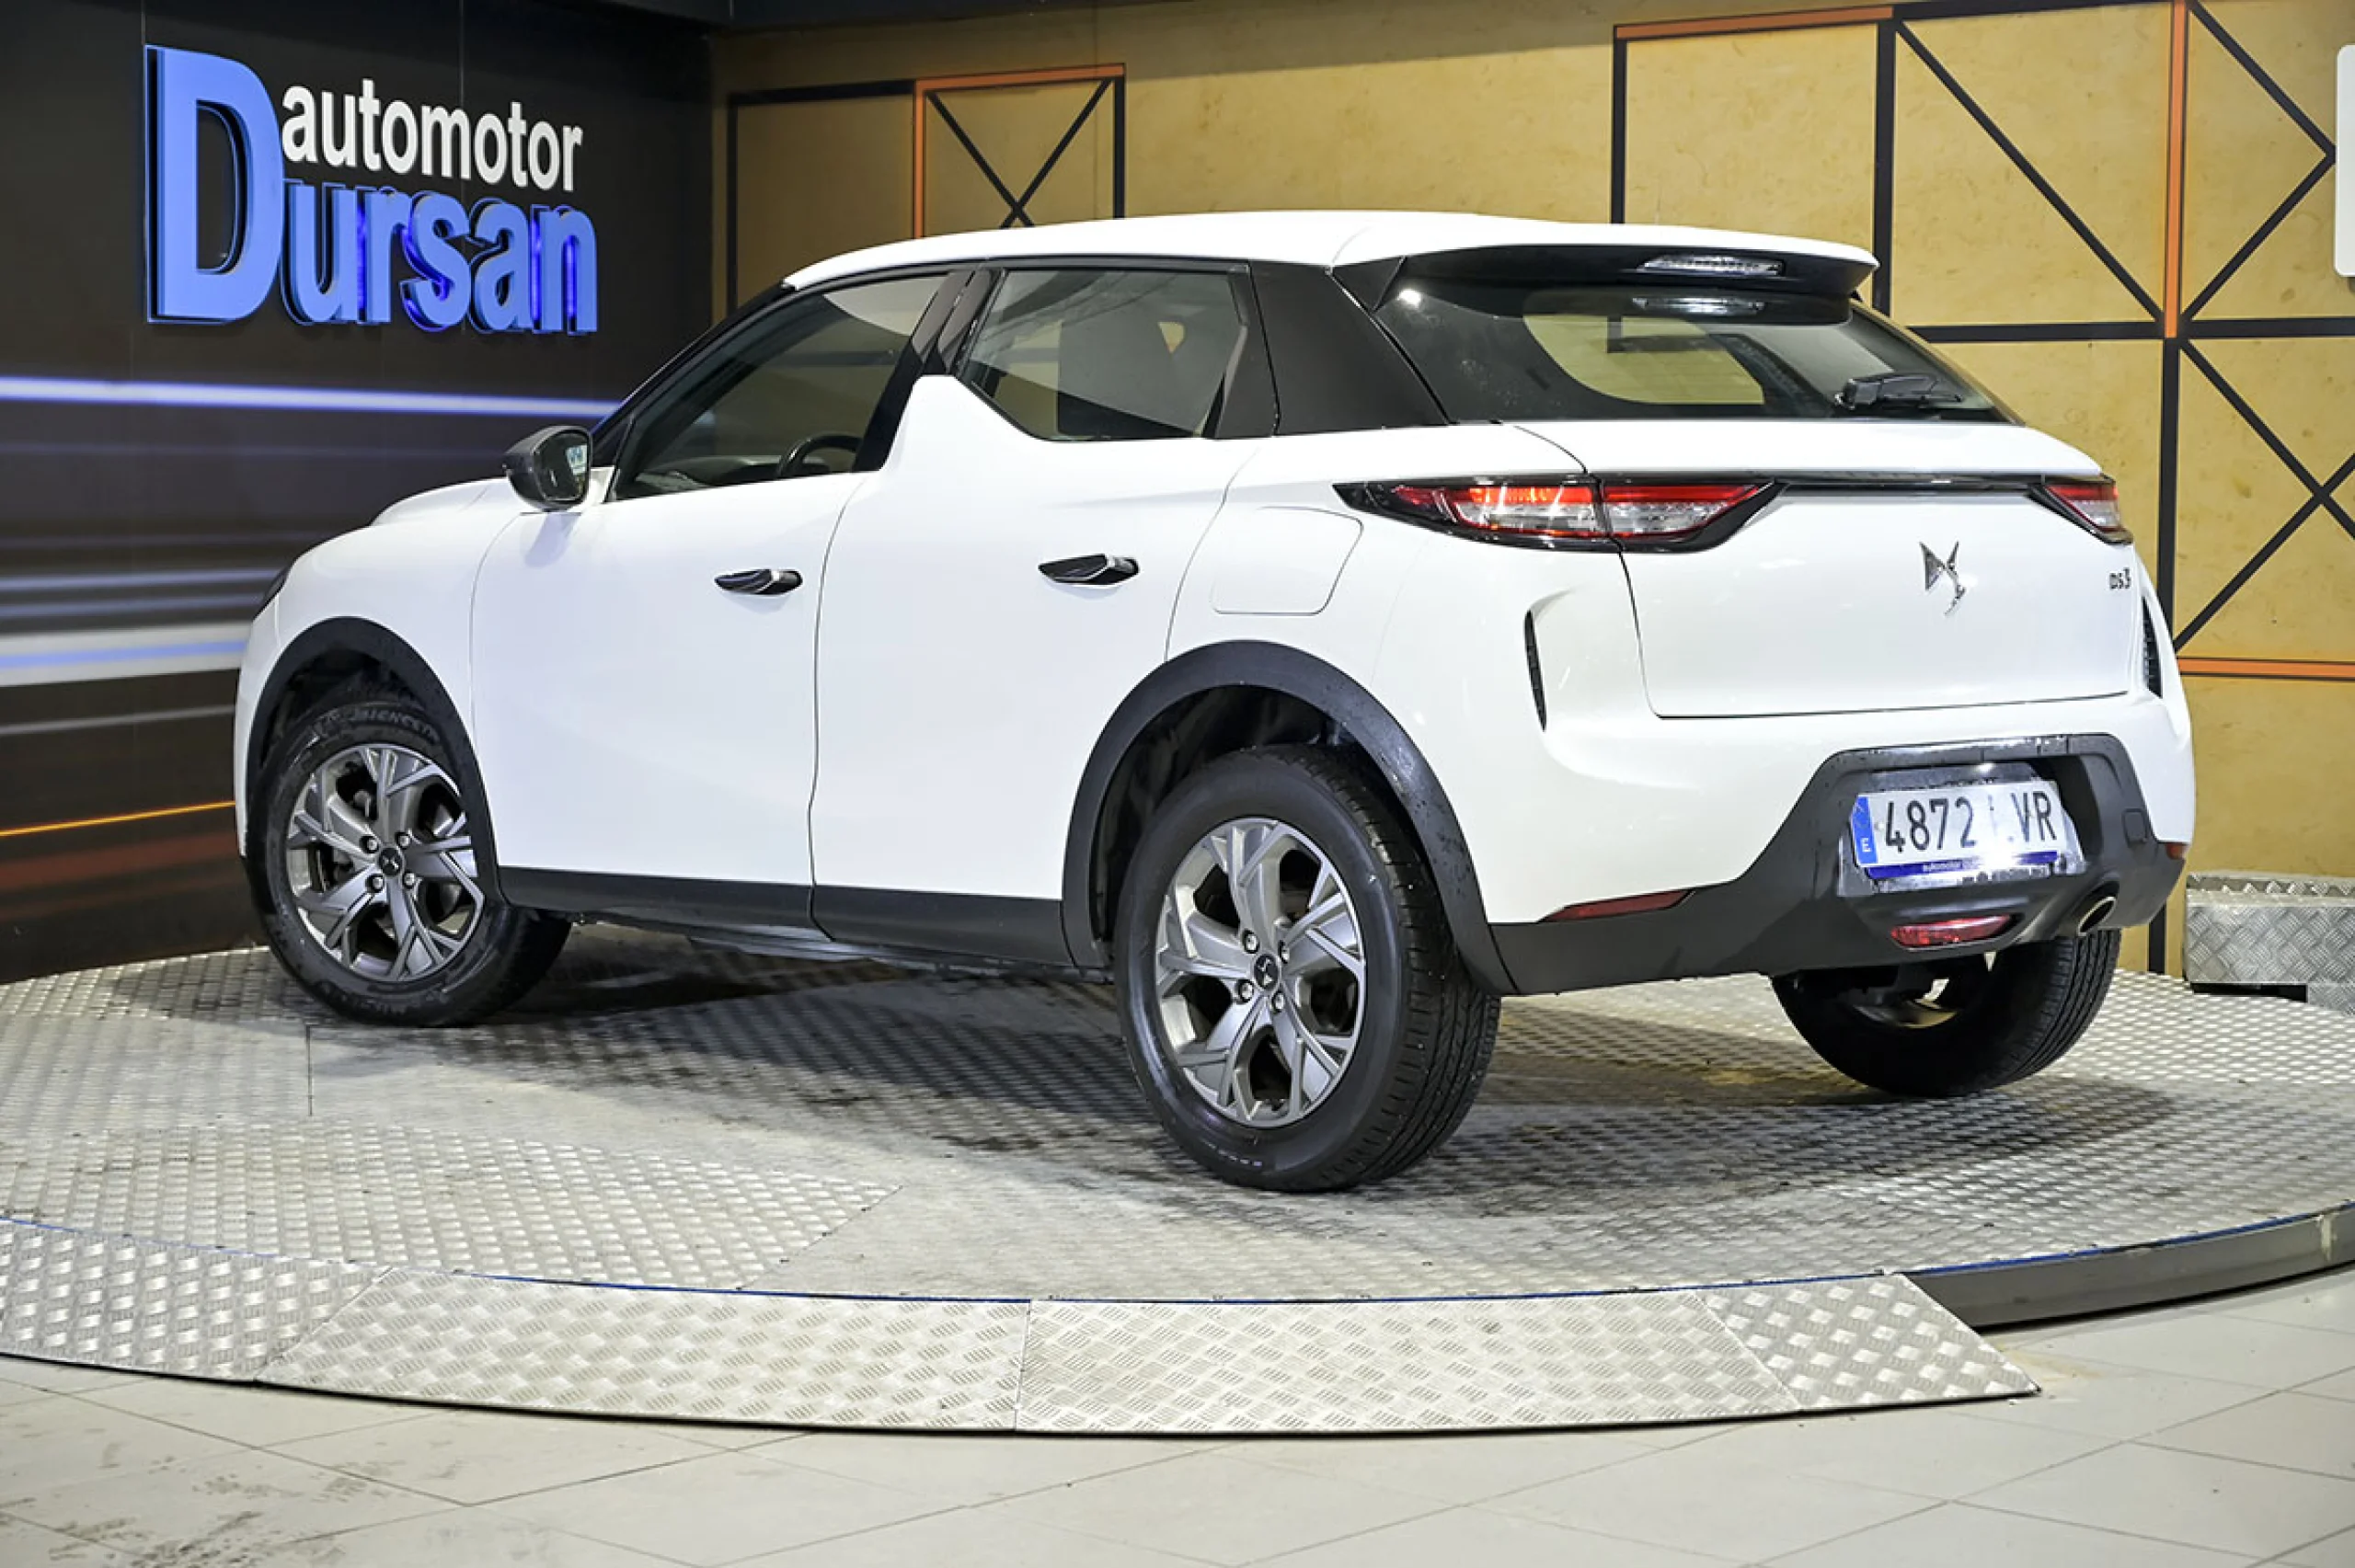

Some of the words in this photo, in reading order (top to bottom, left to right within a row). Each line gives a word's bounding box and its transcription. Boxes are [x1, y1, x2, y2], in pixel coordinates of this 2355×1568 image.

[282, 78, 583, 191] automotor
[145, 44, 598, 335] Dursan
[1861, 837, 1871, 852] E
[1886, 796, 1976, 853] 4872
